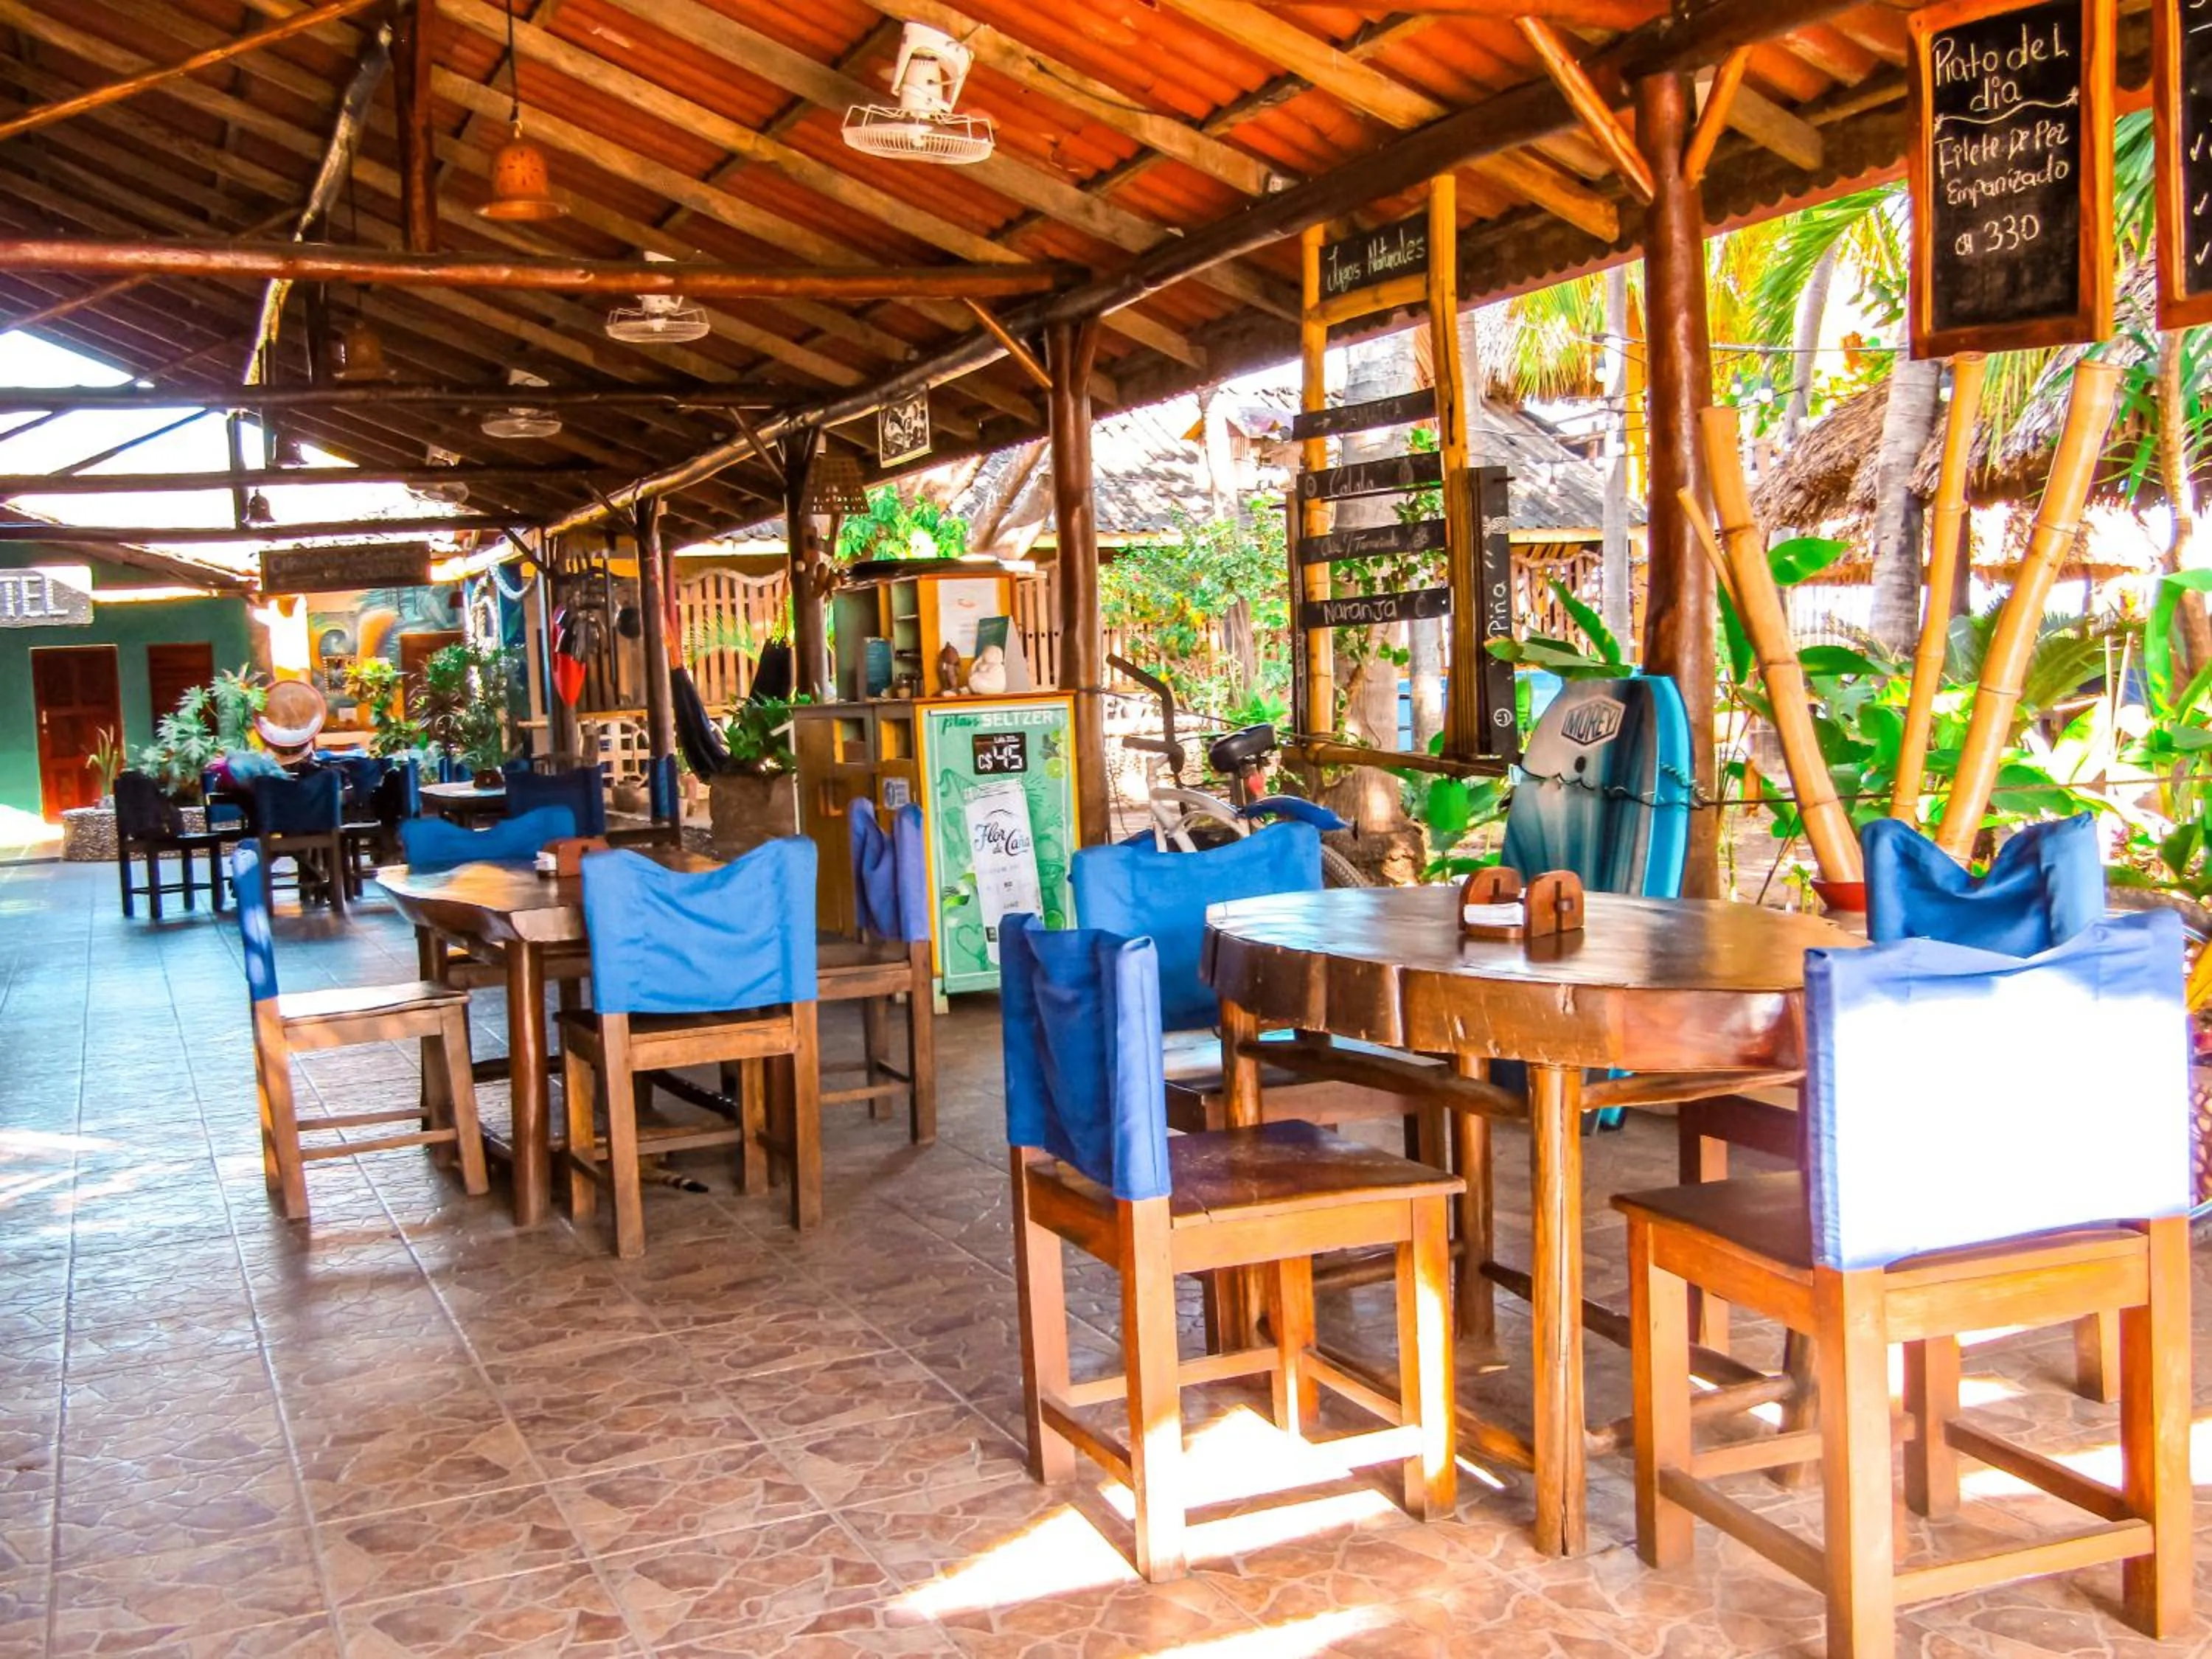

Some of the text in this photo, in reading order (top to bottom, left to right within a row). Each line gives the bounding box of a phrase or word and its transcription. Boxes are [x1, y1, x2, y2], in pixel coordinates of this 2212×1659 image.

[1932, 38, 1998, 87] Plato
[1934, 133, 2000, 180] Filete
[1946, 153, 2070, 209] Empanizado
[1983, 214, 2040, 252] 330
[981, 711, 1054, 728] SELTZER
[1565, 703, 1617, 741] MOREY
[974, 821, 1006, 852] Flor
